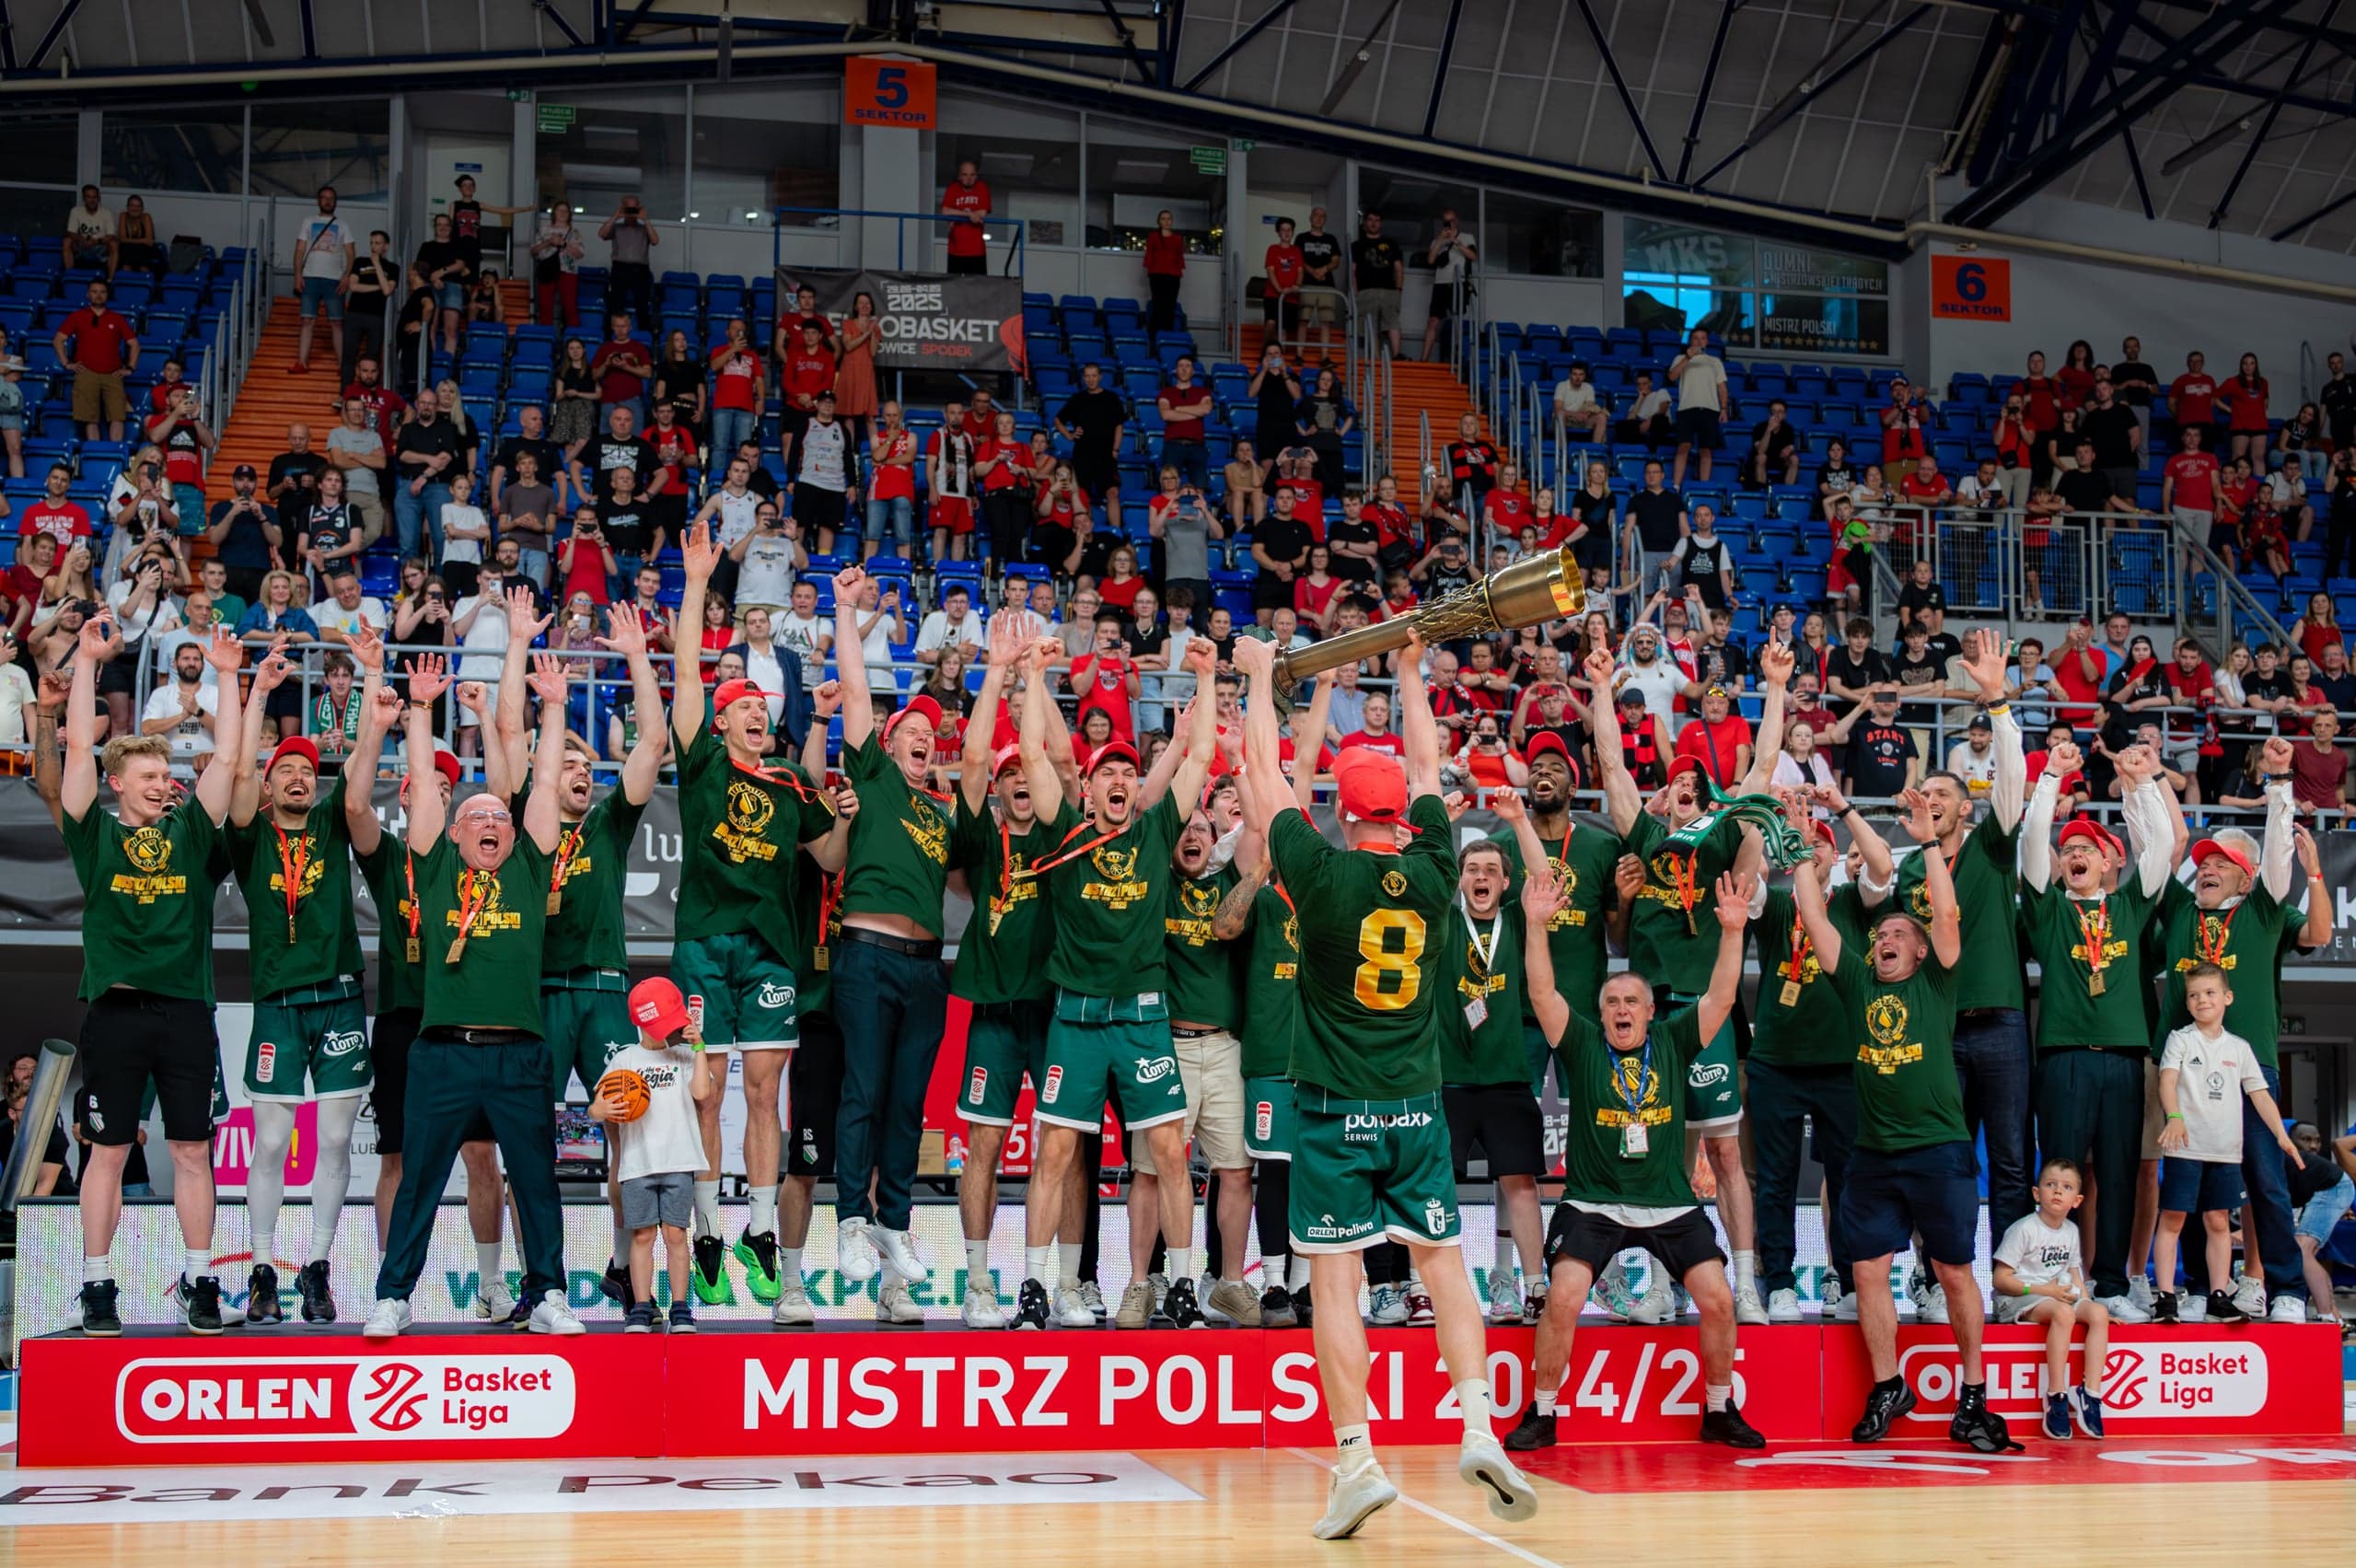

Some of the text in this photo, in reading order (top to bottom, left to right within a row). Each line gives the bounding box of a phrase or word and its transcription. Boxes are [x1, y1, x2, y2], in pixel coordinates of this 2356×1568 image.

[875, 67, 909, 109] 5
[854, 109, 928, 122] SEKTOR
[1645, 234, 1727, 273] MKS
[1957, 263, 1985, 301] 6
[888, 293, 942, 311] 2025
[1940, 302, 2003, 316] SEKTOR
[828, 312, 1000, 343] EOBASKET
[1764, 317, 1837, 335] MISTRZ POLSKI
[921, 343, 972, 357] SPODEK
[334, 517, 345, 528] 3
[1866, 729, 1904, 744] START
[149, 875, 187, 890] POLSKI
[483, 912, 521, 927] POLSKI
[1354, 908, 1426, 1010] 8
[767, 991, 792, 1005] LOTTO
[331, 1035, 359, 1051] LOTTO
[1889, 1043, 1923, 1059] POLSKI
[1143, 1061, 1170, 1079] LOTTO
[1695, 1067, 1723, 1083] LOTTO
[89, 1095, 98, 1109] 6
[1344, 1132, 1378, 1142] SERWIS
[1309, 1220, 1374, 1238] ORLEN Paliwa
[2160, 1353, 2248, 1376] Basket
[443, 1367, 552, 1392] Basket
[142, 1378, 331, 1422] ORLEN
[744, 1356, 1069, 1429] MISTRZ
[2160, 1382, 2213, 1409] Liga
[443, 1399, 509, 1431] Liga
[0, 1471, 1118, 1504] Bank Pekao
